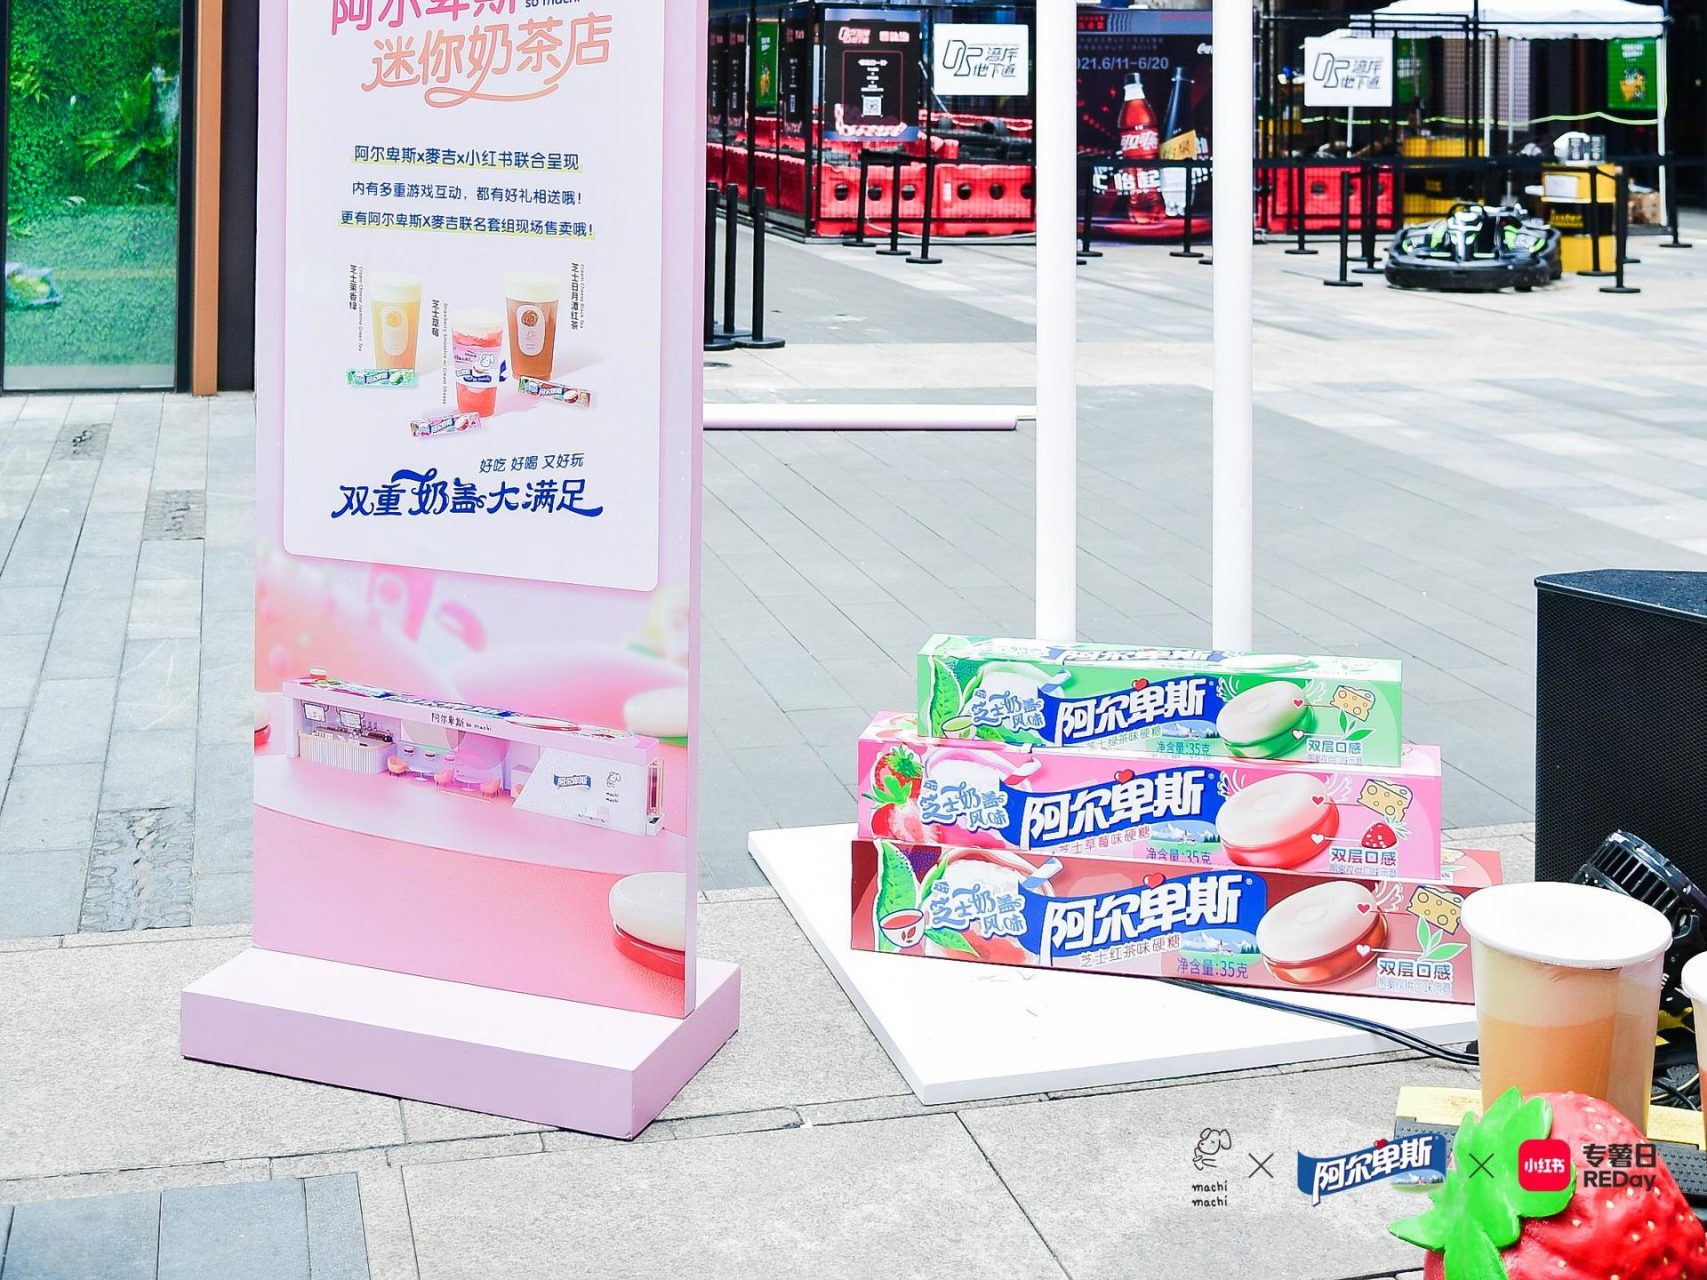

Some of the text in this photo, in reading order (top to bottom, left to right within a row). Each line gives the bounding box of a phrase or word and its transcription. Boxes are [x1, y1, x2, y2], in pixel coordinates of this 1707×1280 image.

[361, 11, 613, 108] 迷你奶茶店
[479, 452, 585, 473] 好吃 好喝 又好玩
[331, 467, 604, 519] 双重奶盖大满足
[1012, 713, 1045, 730] 风味
[1060, 678, 1206, 748] 阿尔卑斯
[1307, 740, 1362, 755] 双层口感
[968, 809, 1008, 828] 风味
[1019, 770, 1205, 851] 阿尔卑斯
[1058, 825, 1150, 854] 芝士草莓味硬糖
[1330, 847, 1397, 866] 双层口感
[983, 914, 1025, 933] 风味
[1039, 874, 1242, 966] 阿尔卑斯
[1080, 934, 1181, 968] 芝士红茶味硬糖
[1176, 957, 1249, 980] 净含量:35克
[1379, 959, 1451, 980] 双层口感
